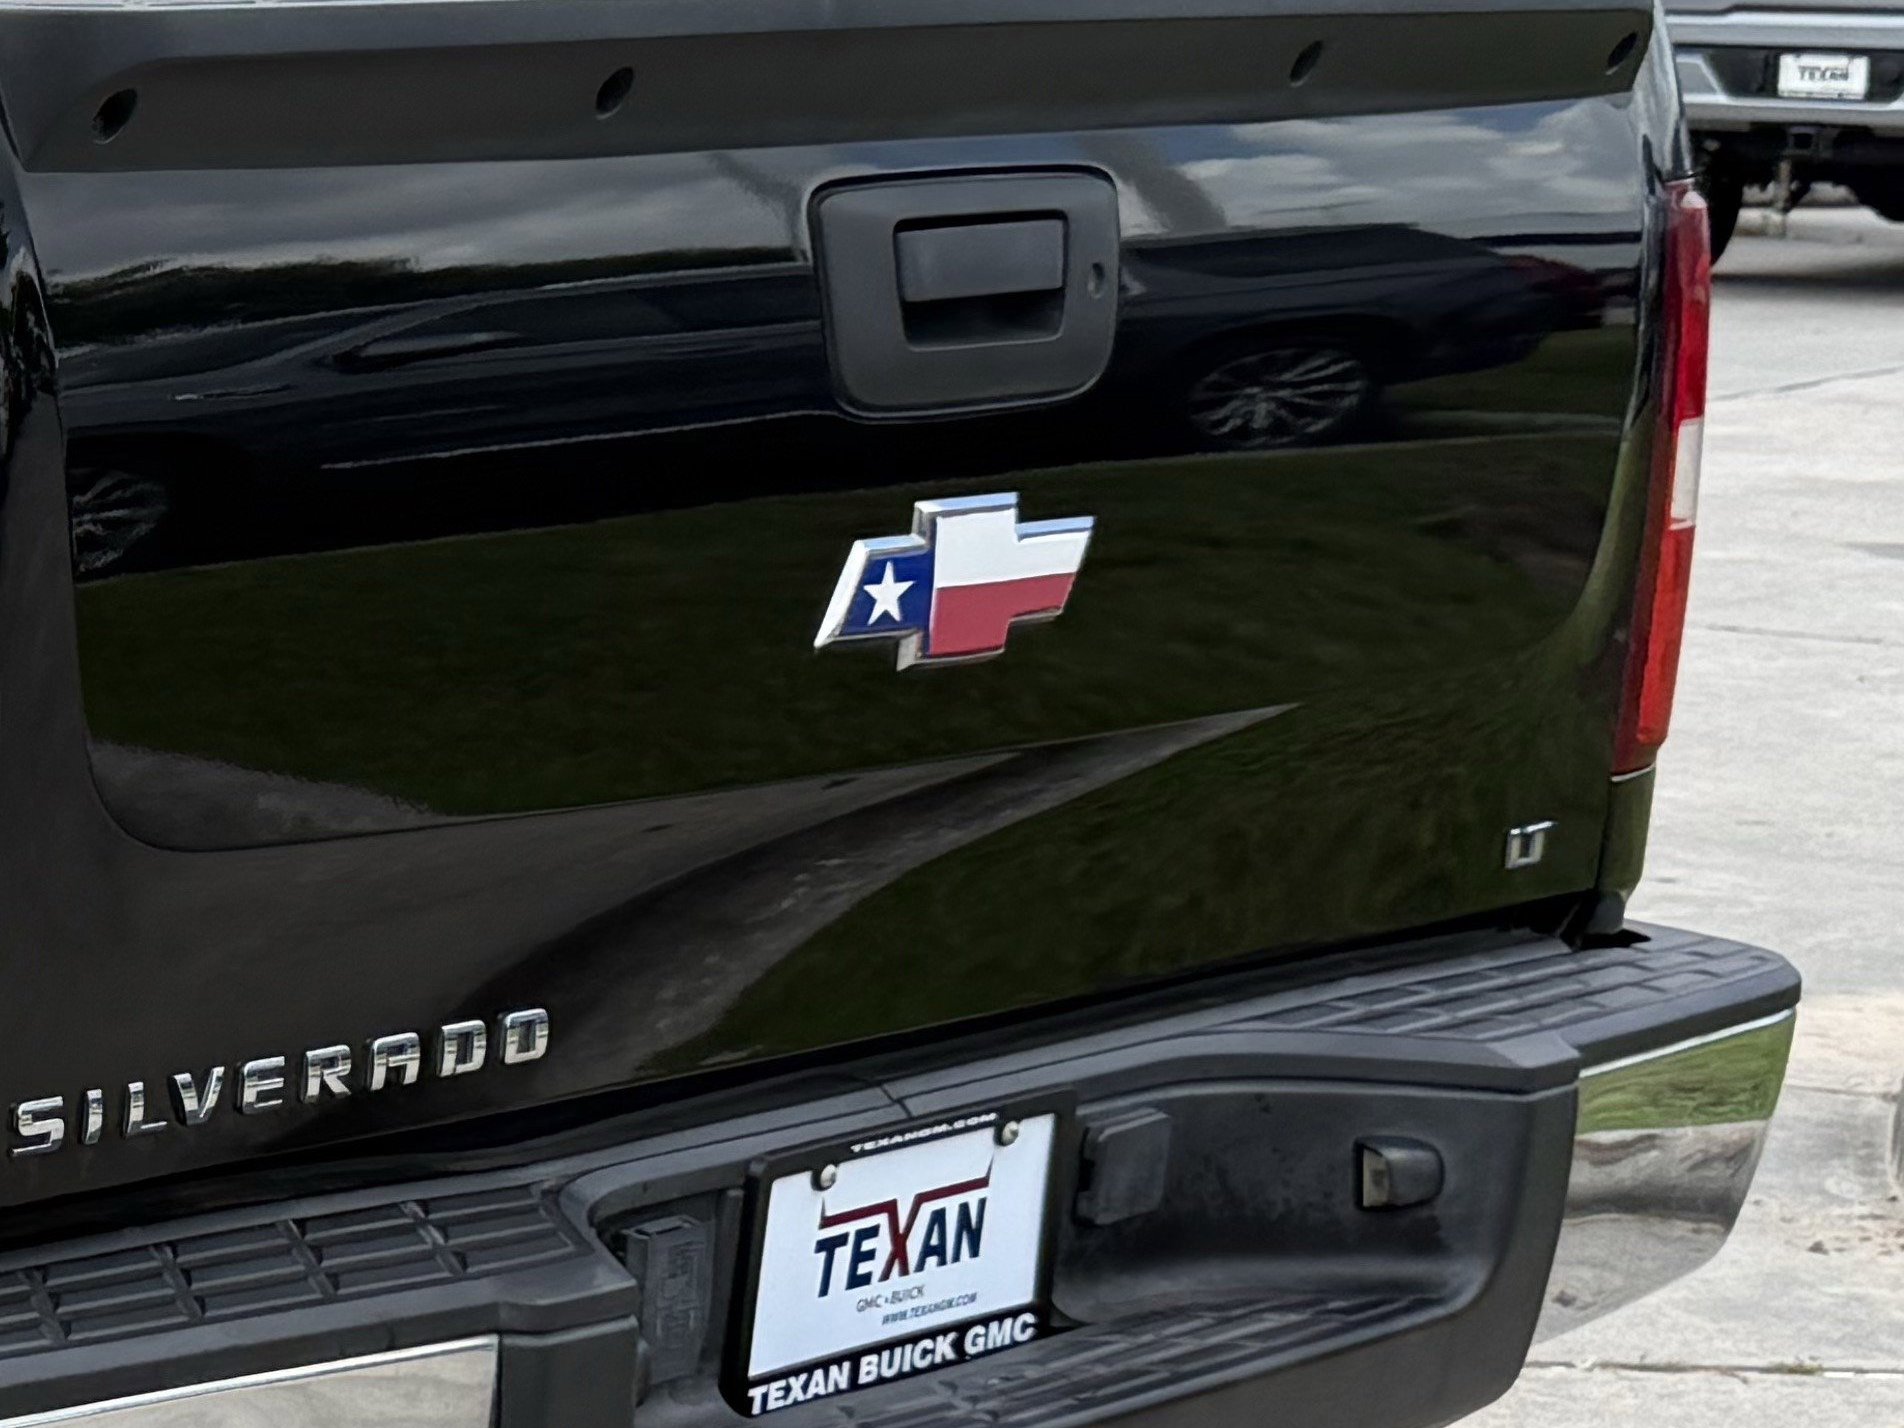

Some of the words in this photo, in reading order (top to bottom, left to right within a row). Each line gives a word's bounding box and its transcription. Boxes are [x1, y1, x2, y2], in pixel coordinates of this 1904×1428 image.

[1504, 819, 1560, 870] LT
[6, 1005, 553, 1158] SILVERADO
[813, 1193, 990, 1299] TEXAN
[746, 1359, 852, 1417] TEXAN
[856, 1331, 960, 1386] BUICK
[963, 1312, 1040, 1356] GMC
